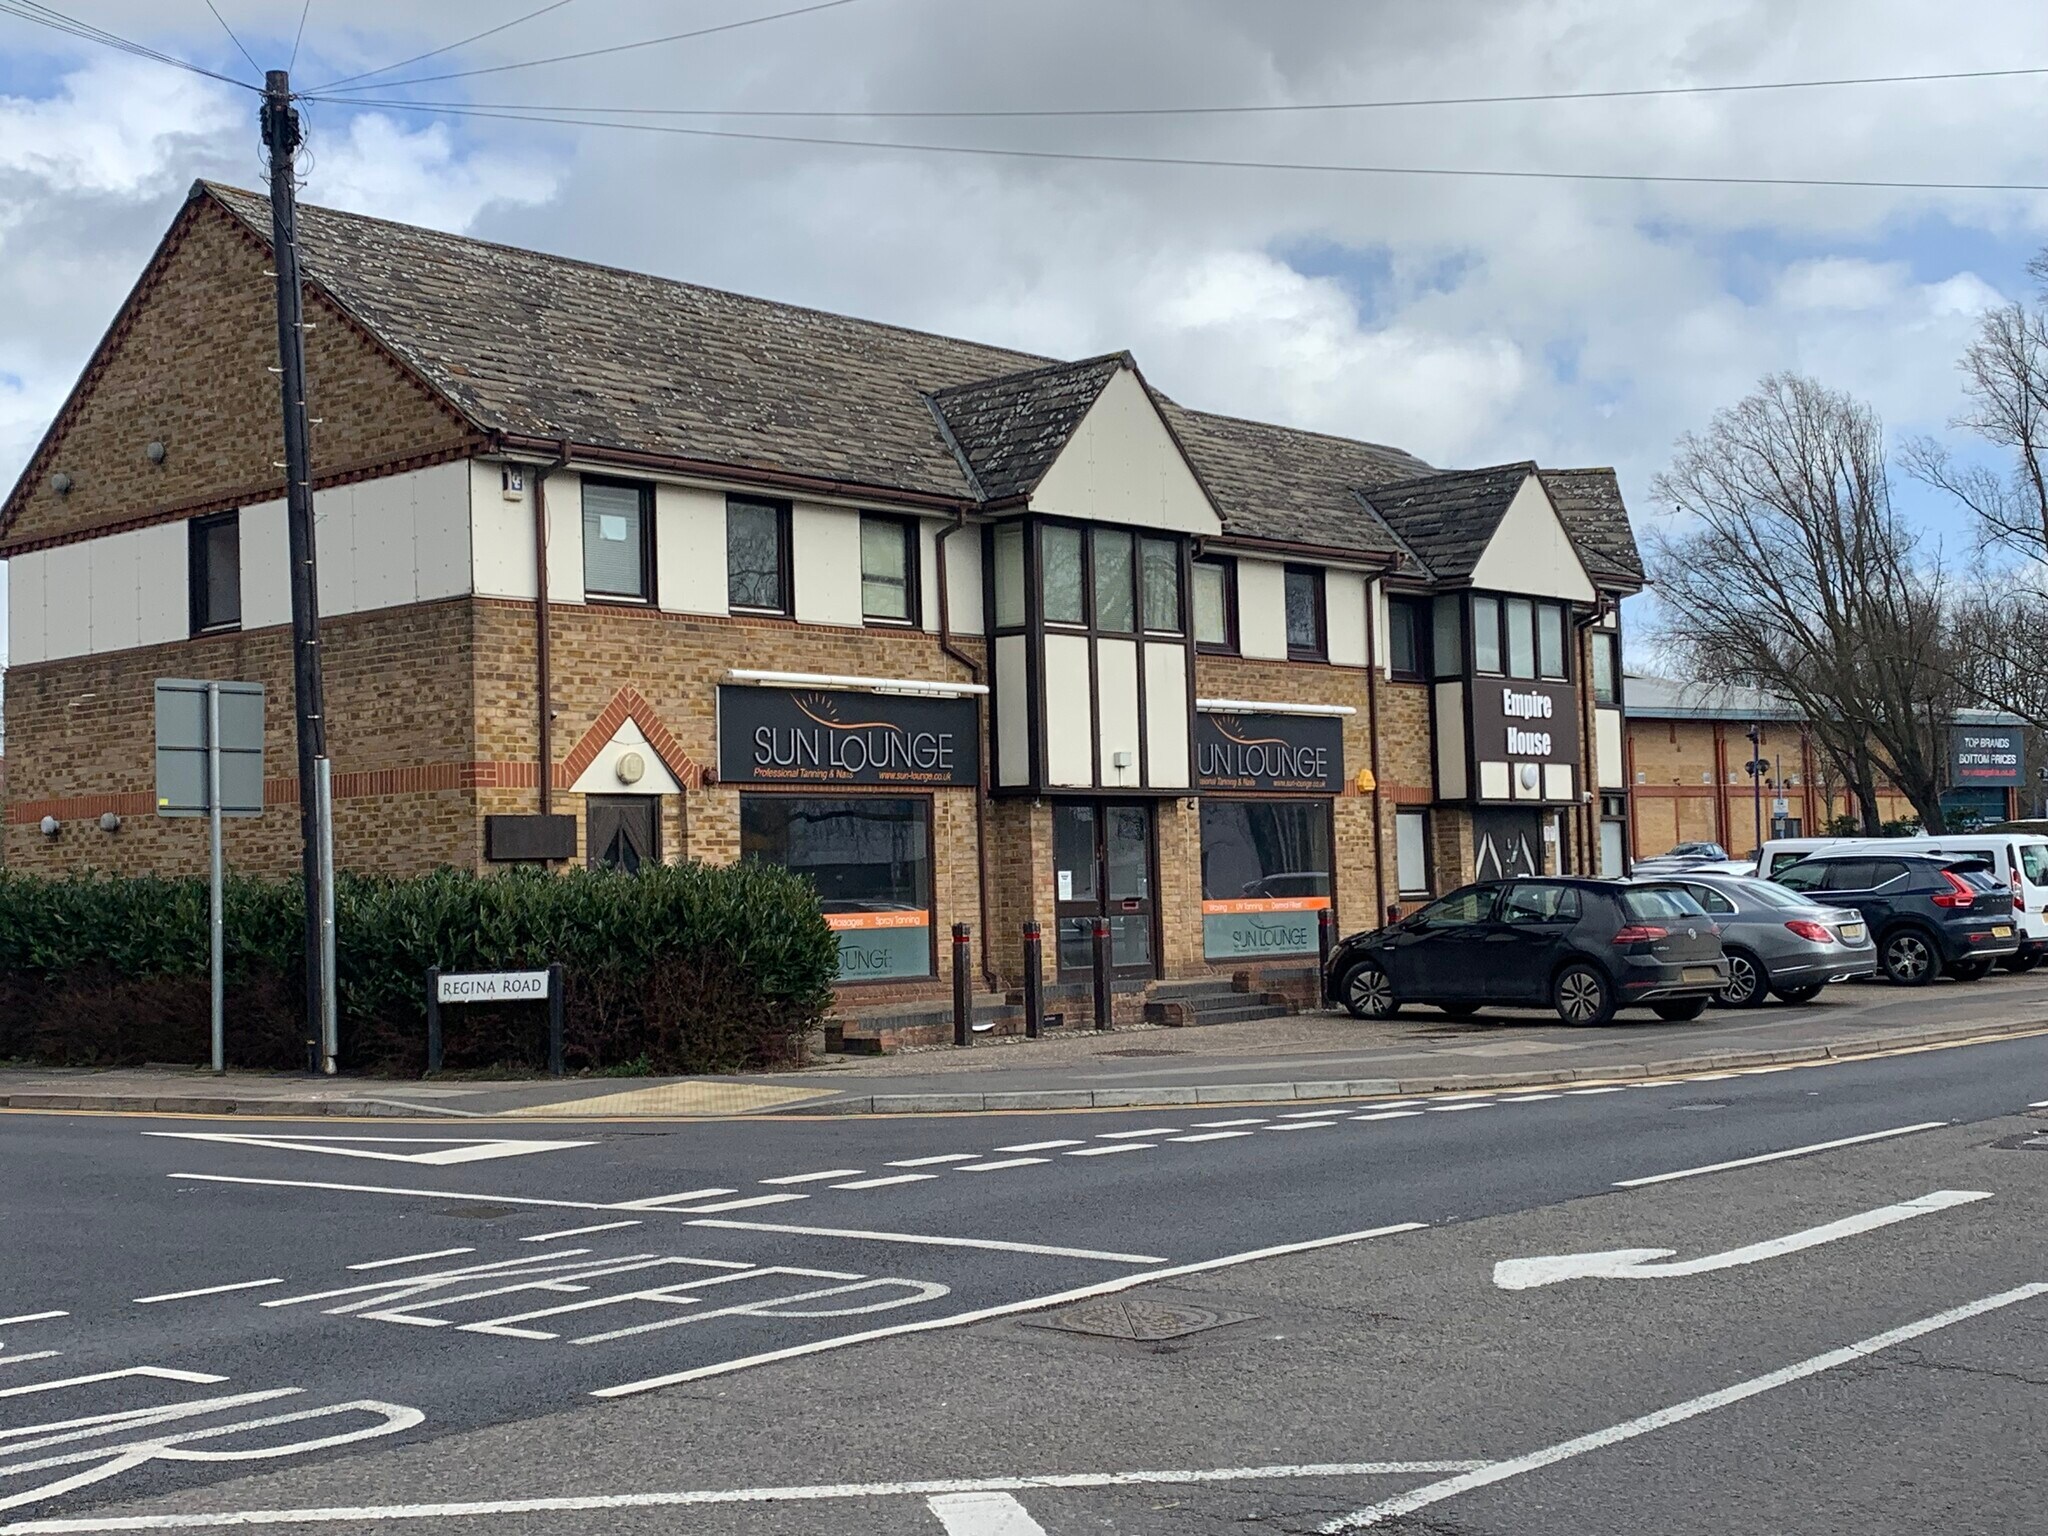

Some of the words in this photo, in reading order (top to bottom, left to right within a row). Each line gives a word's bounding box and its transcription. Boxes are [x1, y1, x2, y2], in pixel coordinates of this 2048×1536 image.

[1503, 689, 1553, 720] Empire
[755, 726, 819, 766] SUN
[829, 728, 953, 773] LOUNGE
[1507, 727, 1551, 756] House
[1964, 738, 1980, 748] TOP
[1980, 738, 2010, 749] BRANDS
[1198, 743, 1231, 775] UN
[1238, 745, 1328, 778] LOUNGE
[1959, 753, 1990, 764] BOTTOM
[1991, 754, 2017, 765] PRICES
[753, 767, 799, 778] Professional
[800, 768, 827, 781] Tanning
[828, 769, 834, 778] &
[829, 917, 864, 928] Massages
[875, 916, 894, 927] Spray
[894, 914, 921, 926] Tanning
[1232, 931, 1257, 949] SUN
[1260, 928, 1308, 947] LOUNGE
[443, 981, 497, 996] REGINA
[503, 979, 542, 993] ROAD
[258, 1248, 952, 1345] KEEP
